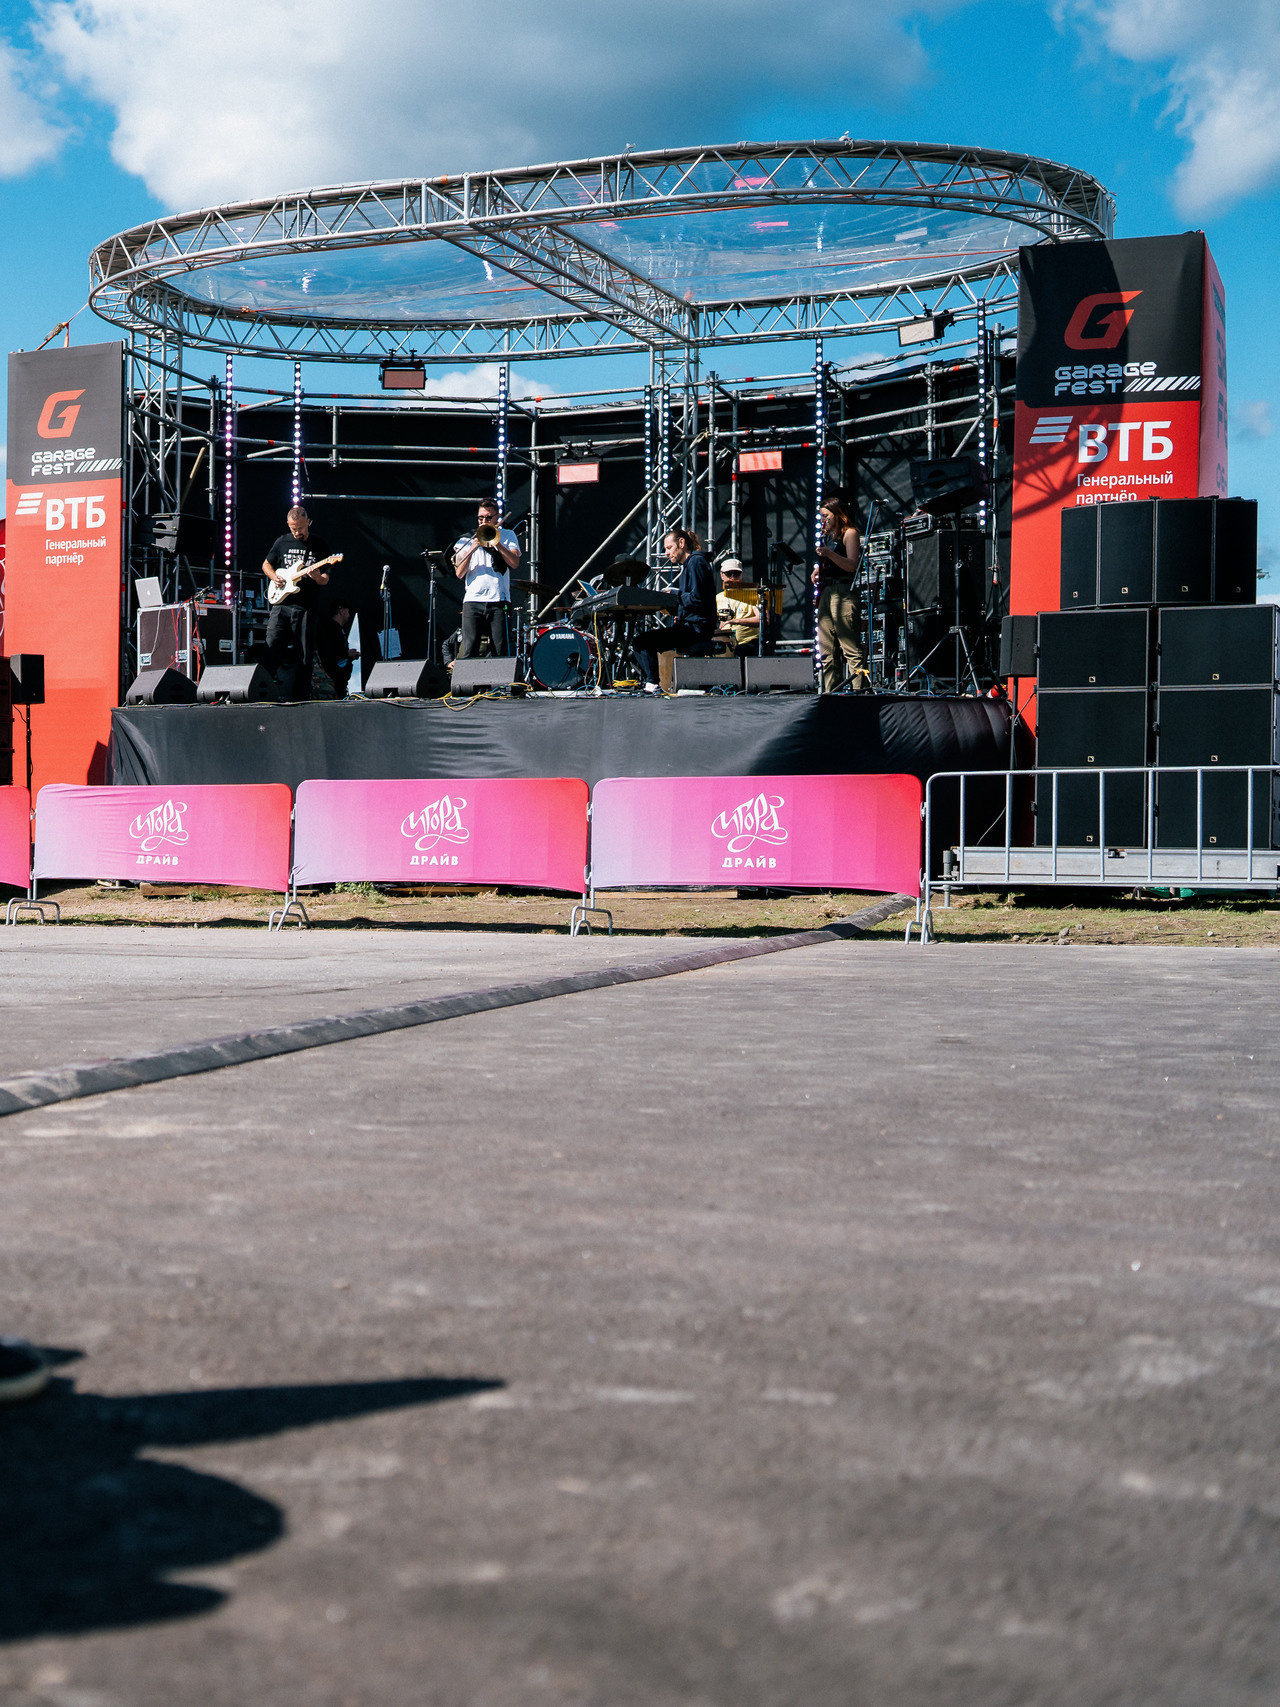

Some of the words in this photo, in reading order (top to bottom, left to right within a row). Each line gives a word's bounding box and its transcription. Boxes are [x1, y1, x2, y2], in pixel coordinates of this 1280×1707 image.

[1078, 420, 1174, 464] ВТБ
[1077, 470, 1174, 489] Генеральный
[1076, 489, 1137, 505] партнёр
[45, 494, 107, 532] ВТБ
[45, 535, 107, 552] Генеральный
[45, 552, 84, 567] партнёр
[135, 854, 179, 866] ДРАЙВ
[410, 854, 459, 866] ДРАЙВ
[722, 856, 777, 868] ДРАЙВ
